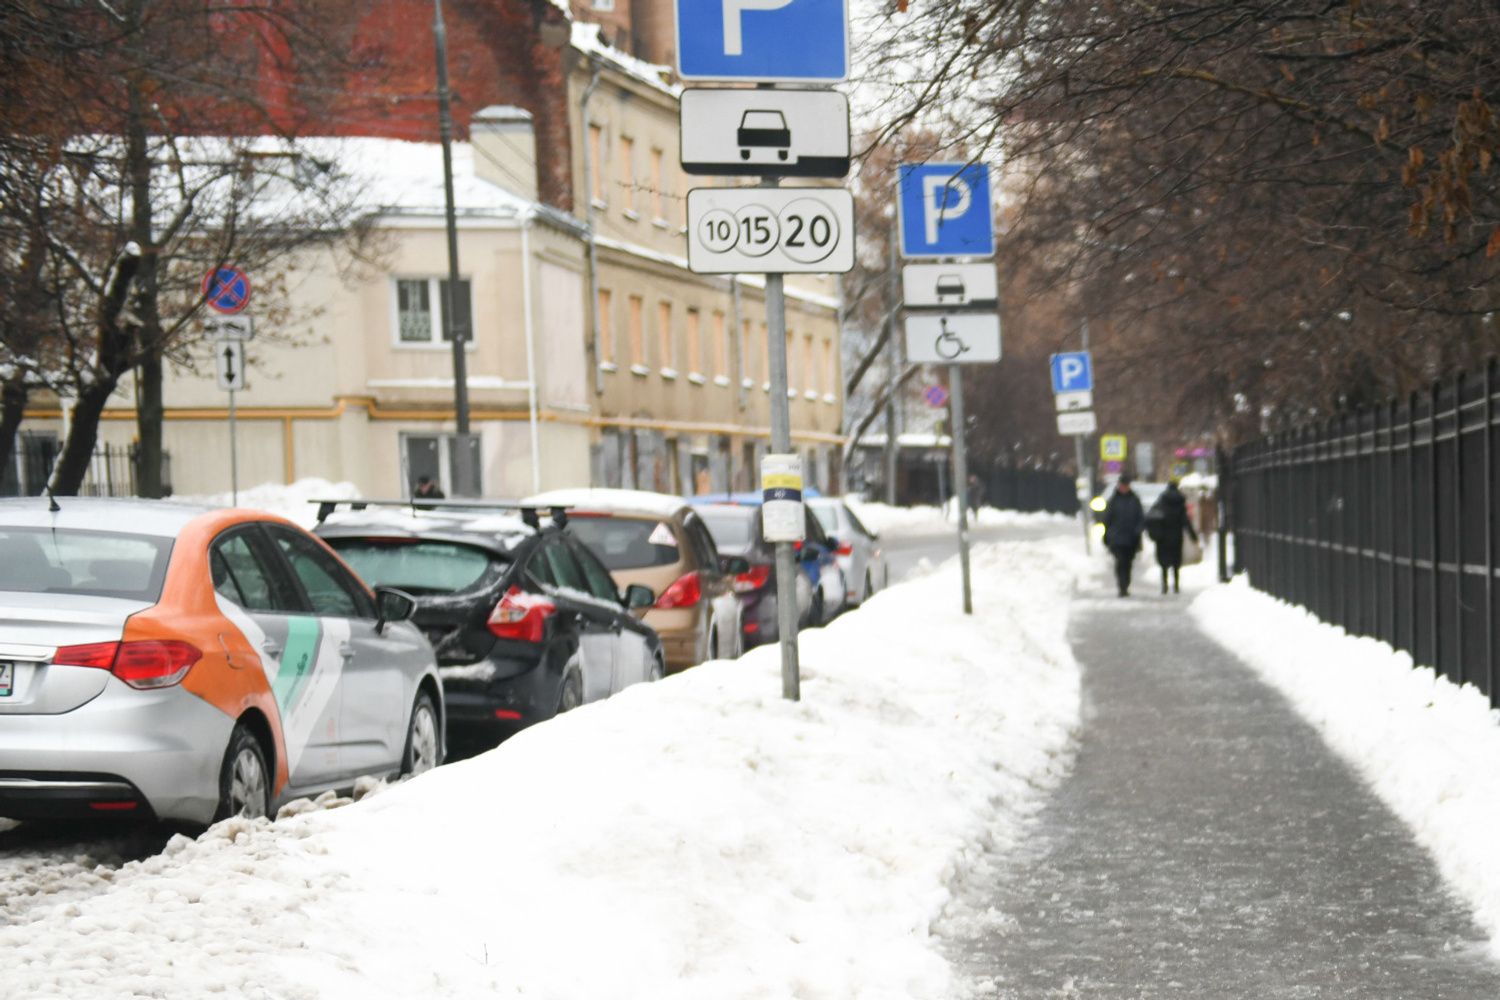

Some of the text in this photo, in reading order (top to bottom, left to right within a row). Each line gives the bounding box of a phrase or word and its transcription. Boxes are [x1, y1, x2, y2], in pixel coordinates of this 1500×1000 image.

[922, 174, 971, 245] P
[706, 214, 830, 247] 10 15 20
[1060, 358, 1084, 388] P
